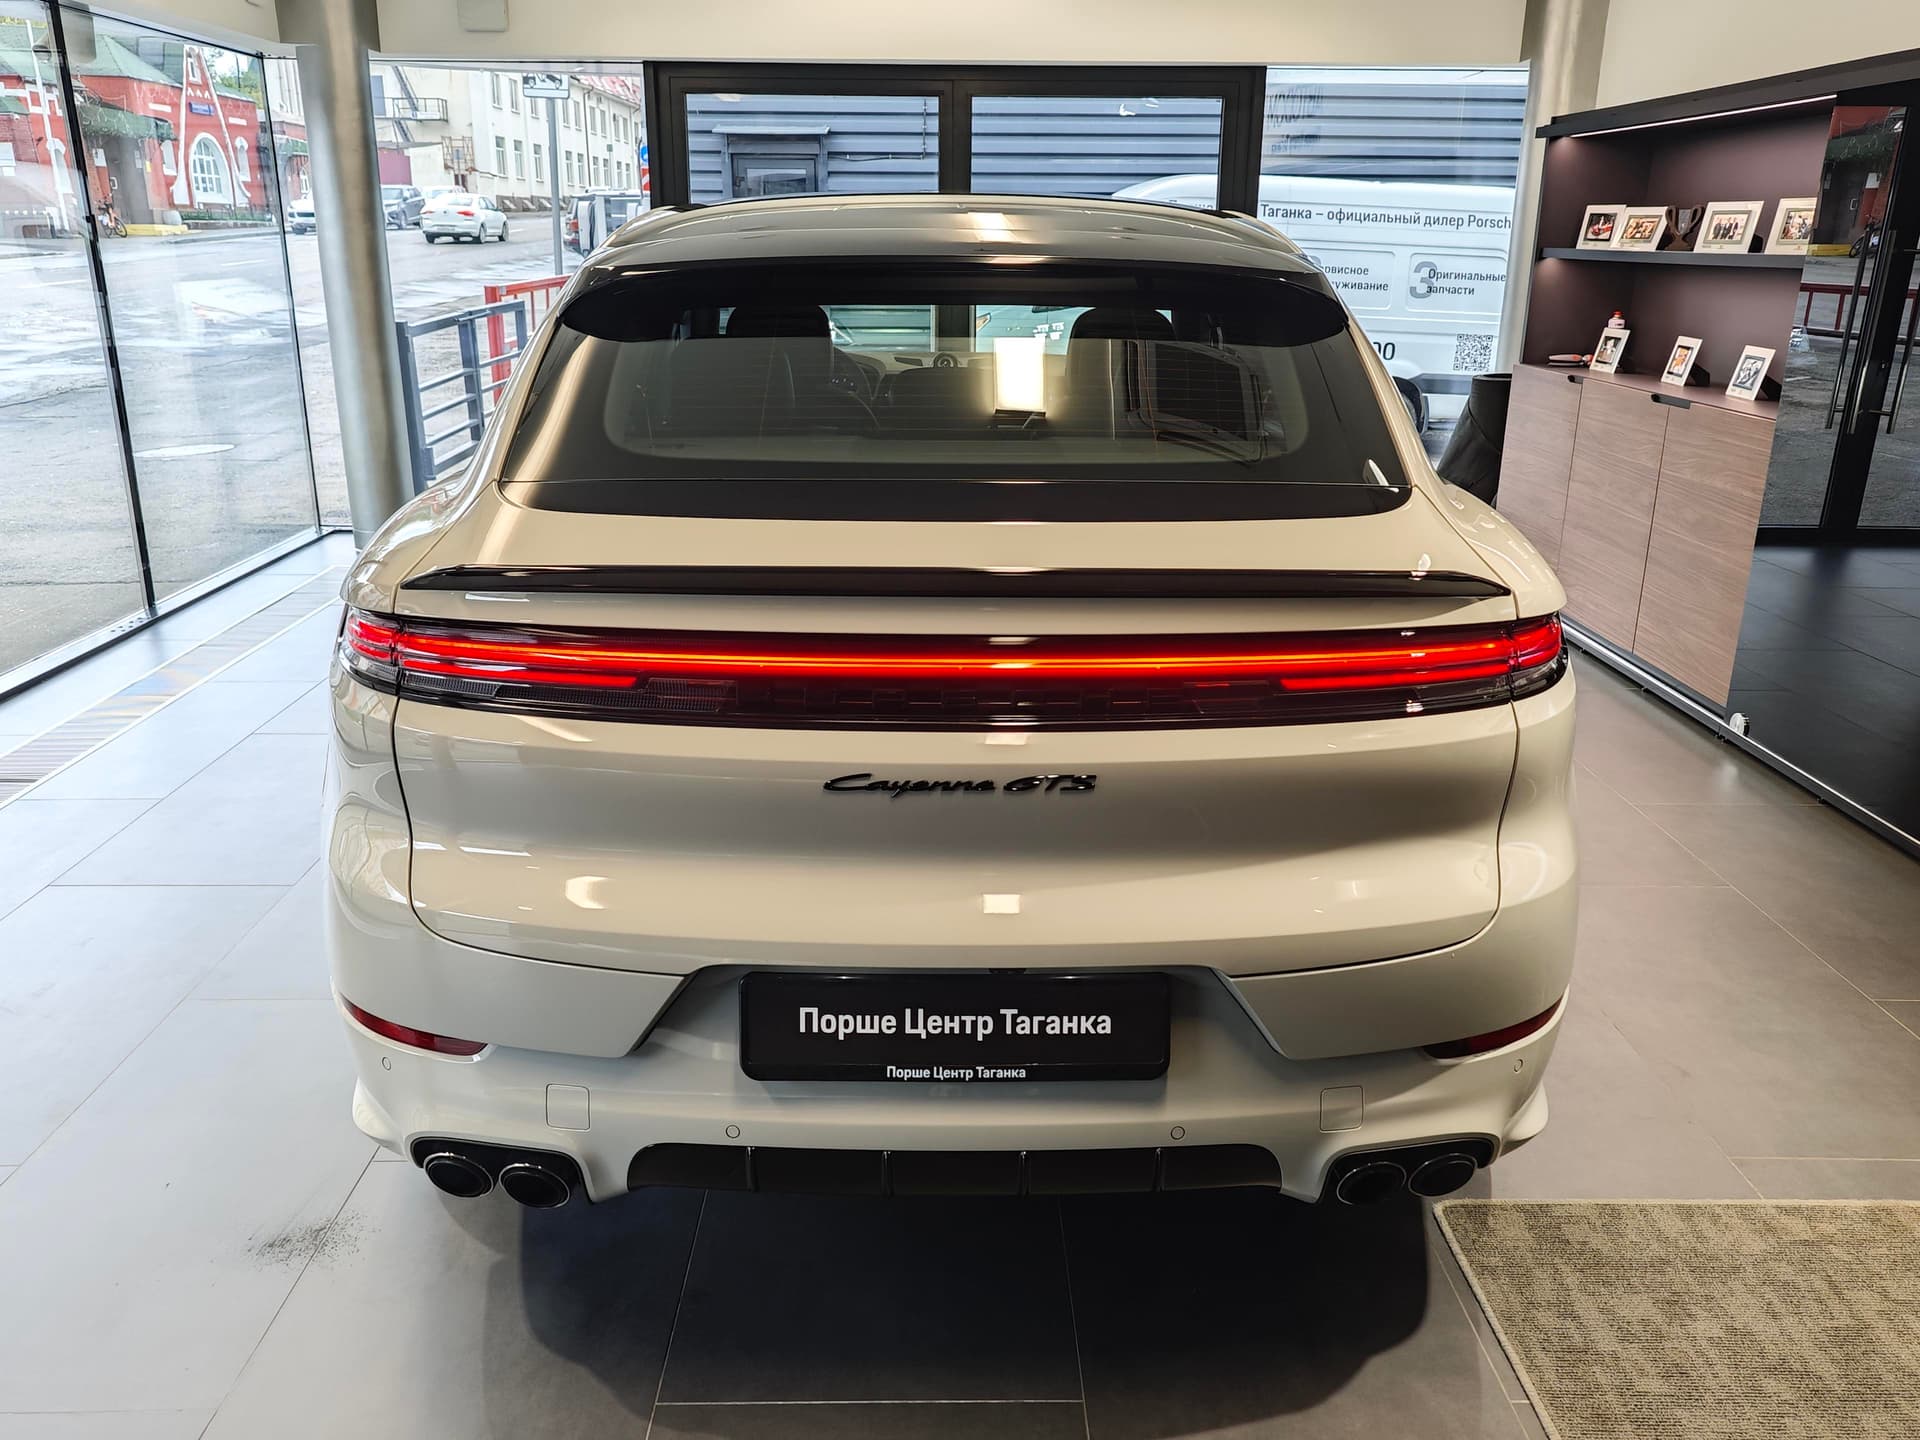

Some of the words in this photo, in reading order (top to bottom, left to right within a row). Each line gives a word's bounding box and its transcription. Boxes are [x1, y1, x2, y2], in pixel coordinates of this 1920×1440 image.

[1260, 203, 1312, 219] Таганка
[1327, 207, 1421, 225] официальный
[1423, 214, 1465, 230] дилер
[1321, 265, 1369, 276] рвисное
[1428, 268, 1506, 282] Оригинальные
[1332, 281, 1389, 292] уживание
[1409, 260, 1438, 299] 3
[1426, 285, 1475, 296] запчасти
[822, 773, 997, 798] Cayenne
[1003, 774, 1097, 792] GTS
[799, 1007, 897, 1040] Порше
[904, 1008, 994, 1041] Центр
[999, 1008, 1112, 1035] Таганка
[886, 1066, 931, 1079] Порше
[933, 1066, 974, 1081] Центр
[976, 1066, 1027, 1079] Таганка
